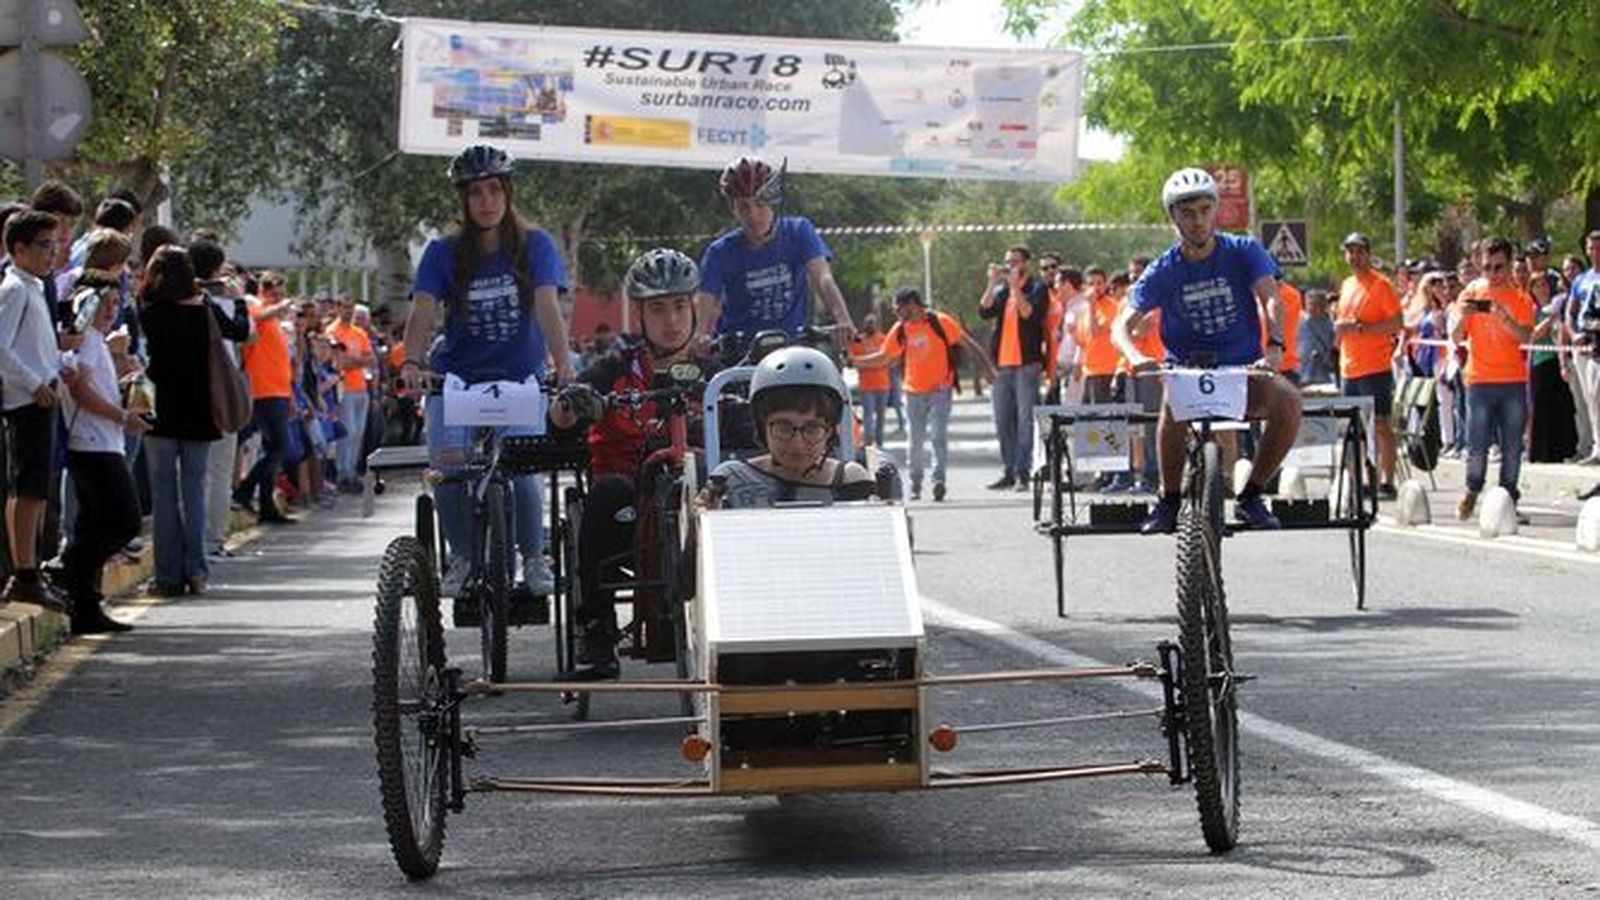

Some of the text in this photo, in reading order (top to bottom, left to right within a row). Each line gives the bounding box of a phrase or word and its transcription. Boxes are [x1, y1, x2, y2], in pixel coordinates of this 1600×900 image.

[583, 45, 803, 78] #SUR18
[604, 72, 793, 92] Sustainable Urban Race
[640, 91, 811, 112] surbanrace.com
[697, 127, 749, 145] FECYT
[1198, 372, 1216, 395] 6
